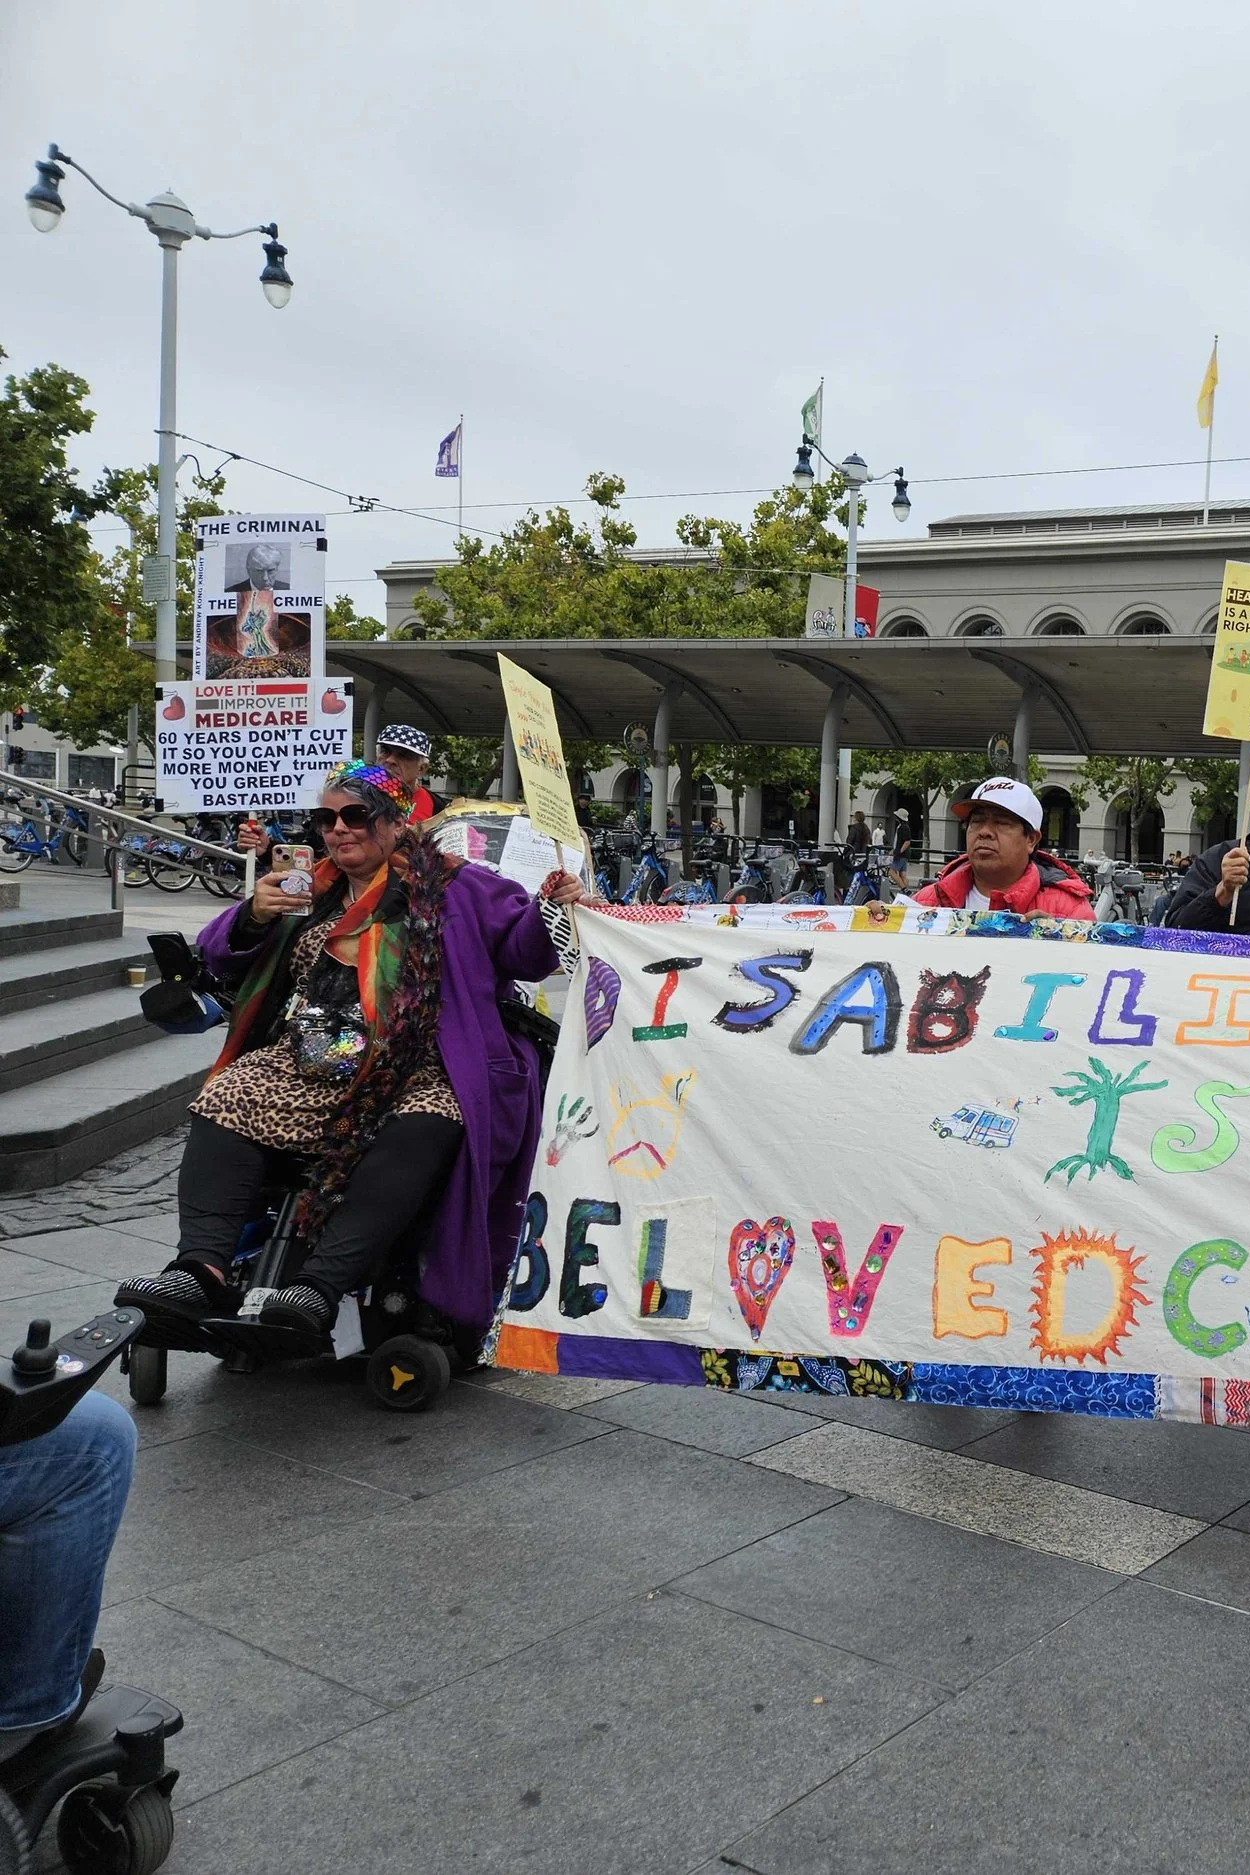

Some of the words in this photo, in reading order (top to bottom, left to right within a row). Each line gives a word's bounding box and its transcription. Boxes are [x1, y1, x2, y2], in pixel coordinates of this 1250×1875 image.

[198, 522, 231, 536] THE
[236, 520, 325, 533] CRIMINAL
[207, 598, 237, 610] THE
[273, 596, 323, 607] CRIME
[1225, 607, 1236, 618] IS
[1239, 609, 1248, 620] A
[195, 685, 234, 697] LOVE
[238, 684, 255, 696] IT!
[220, 697, 286, 710] IMPROVE
[291, 696, 308, 708] IT!
[195, 710, 308, 729] MEDICARE
[158, 732, 177, 744] 60
[184, 731, 241, 745] YEARS
[248, 729, 303, 743] DON'T
[309, 729, 348, 741] CUT
[162, 748, 178, 760] IT
[182, 748, 205, 760] SO
[209, 747, 246, 759] YOU
[251, 745, 288, 758] CAN
[293, 743, 343, 757] HAVE
[163, 763, 212, 775] MORE
[218, 760, 281, 774] MONEY
[293, 760, 337, 770] trum
[191, 777, 227, 790] YOU
[234, 774, 305, 789] GREEDY
[203, 792, 296, 806] BASTARD!!
[508, 1191, 1153, 1367] BELOVED
